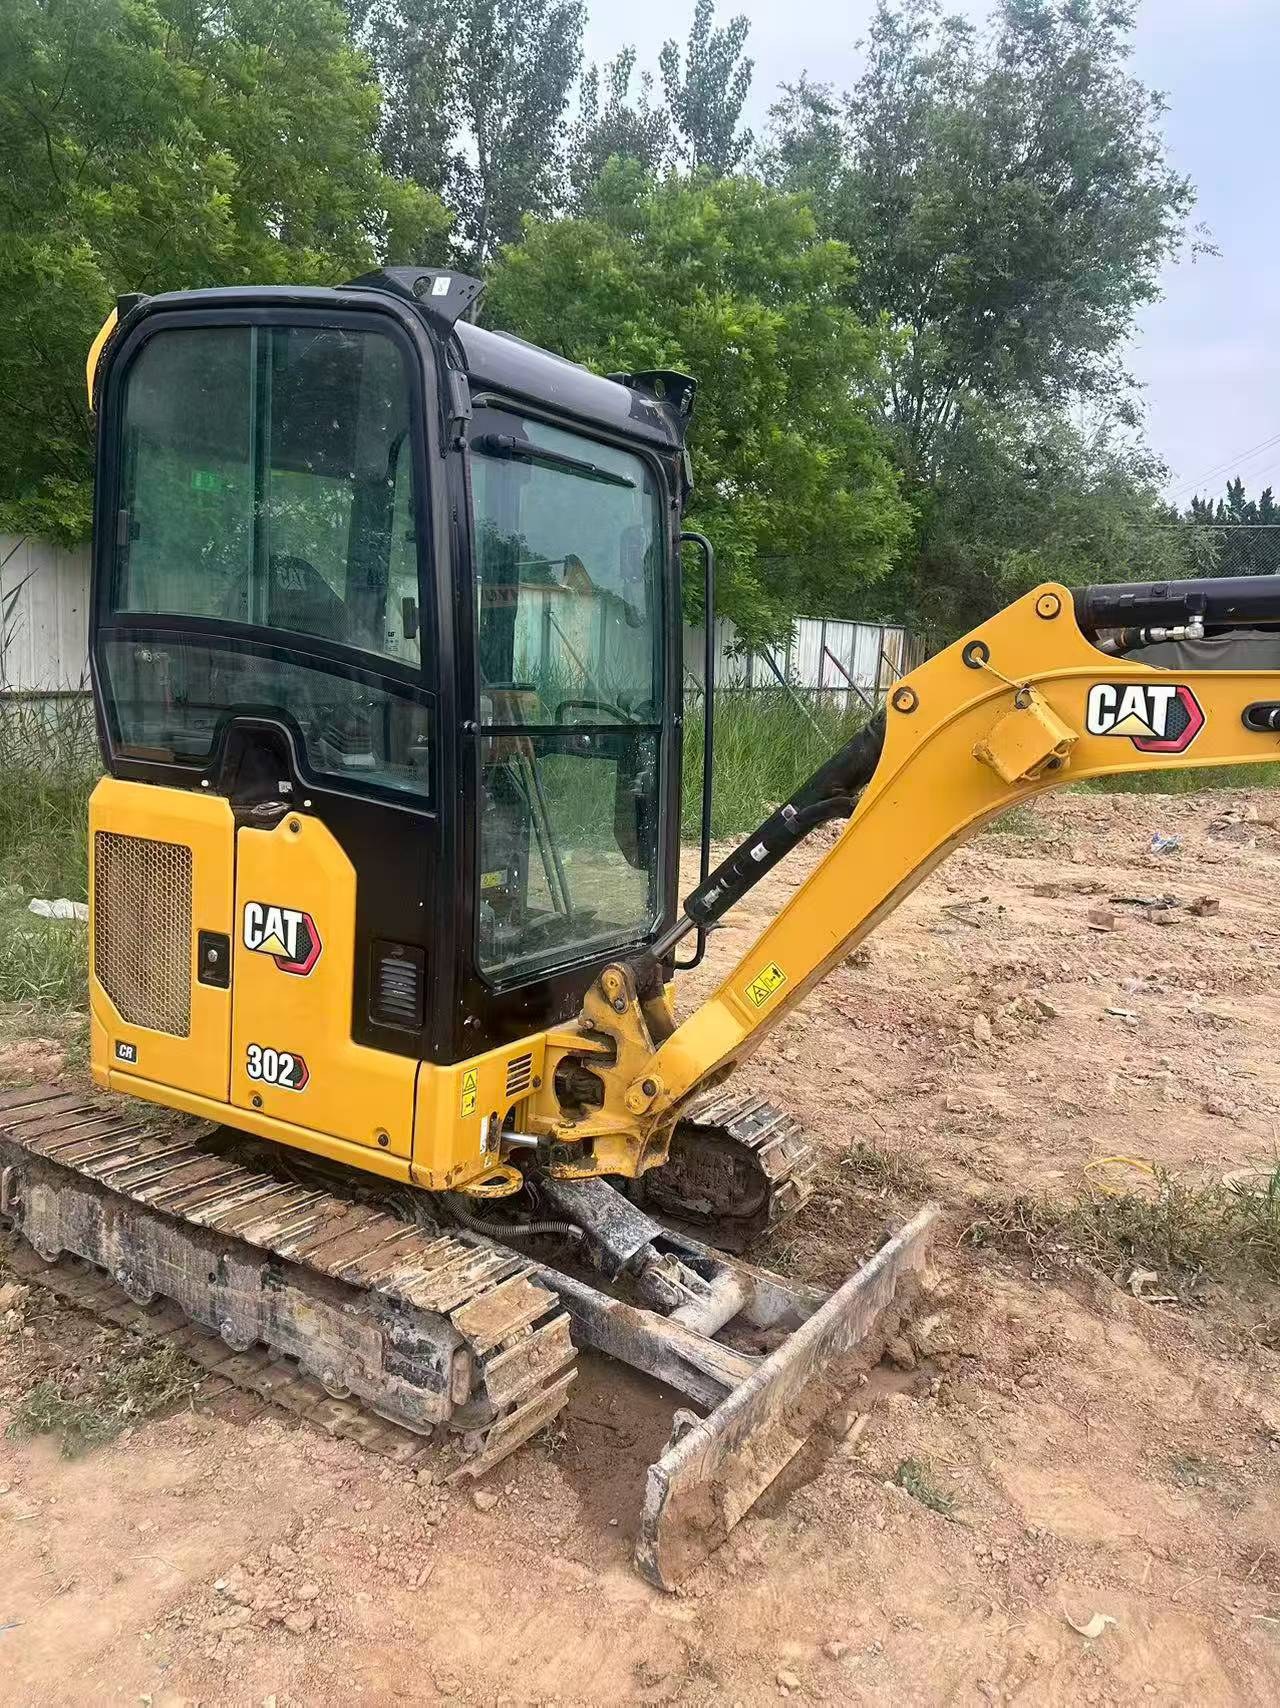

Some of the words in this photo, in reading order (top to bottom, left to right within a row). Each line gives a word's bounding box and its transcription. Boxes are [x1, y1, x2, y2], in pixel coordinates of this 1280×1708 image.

[1088, 684, 1177, 736] CAT
[244, 902, 304, 959] CAT
[118, 1044, 134, 1059] CR
[247, 1044, 295, 1087] 302
